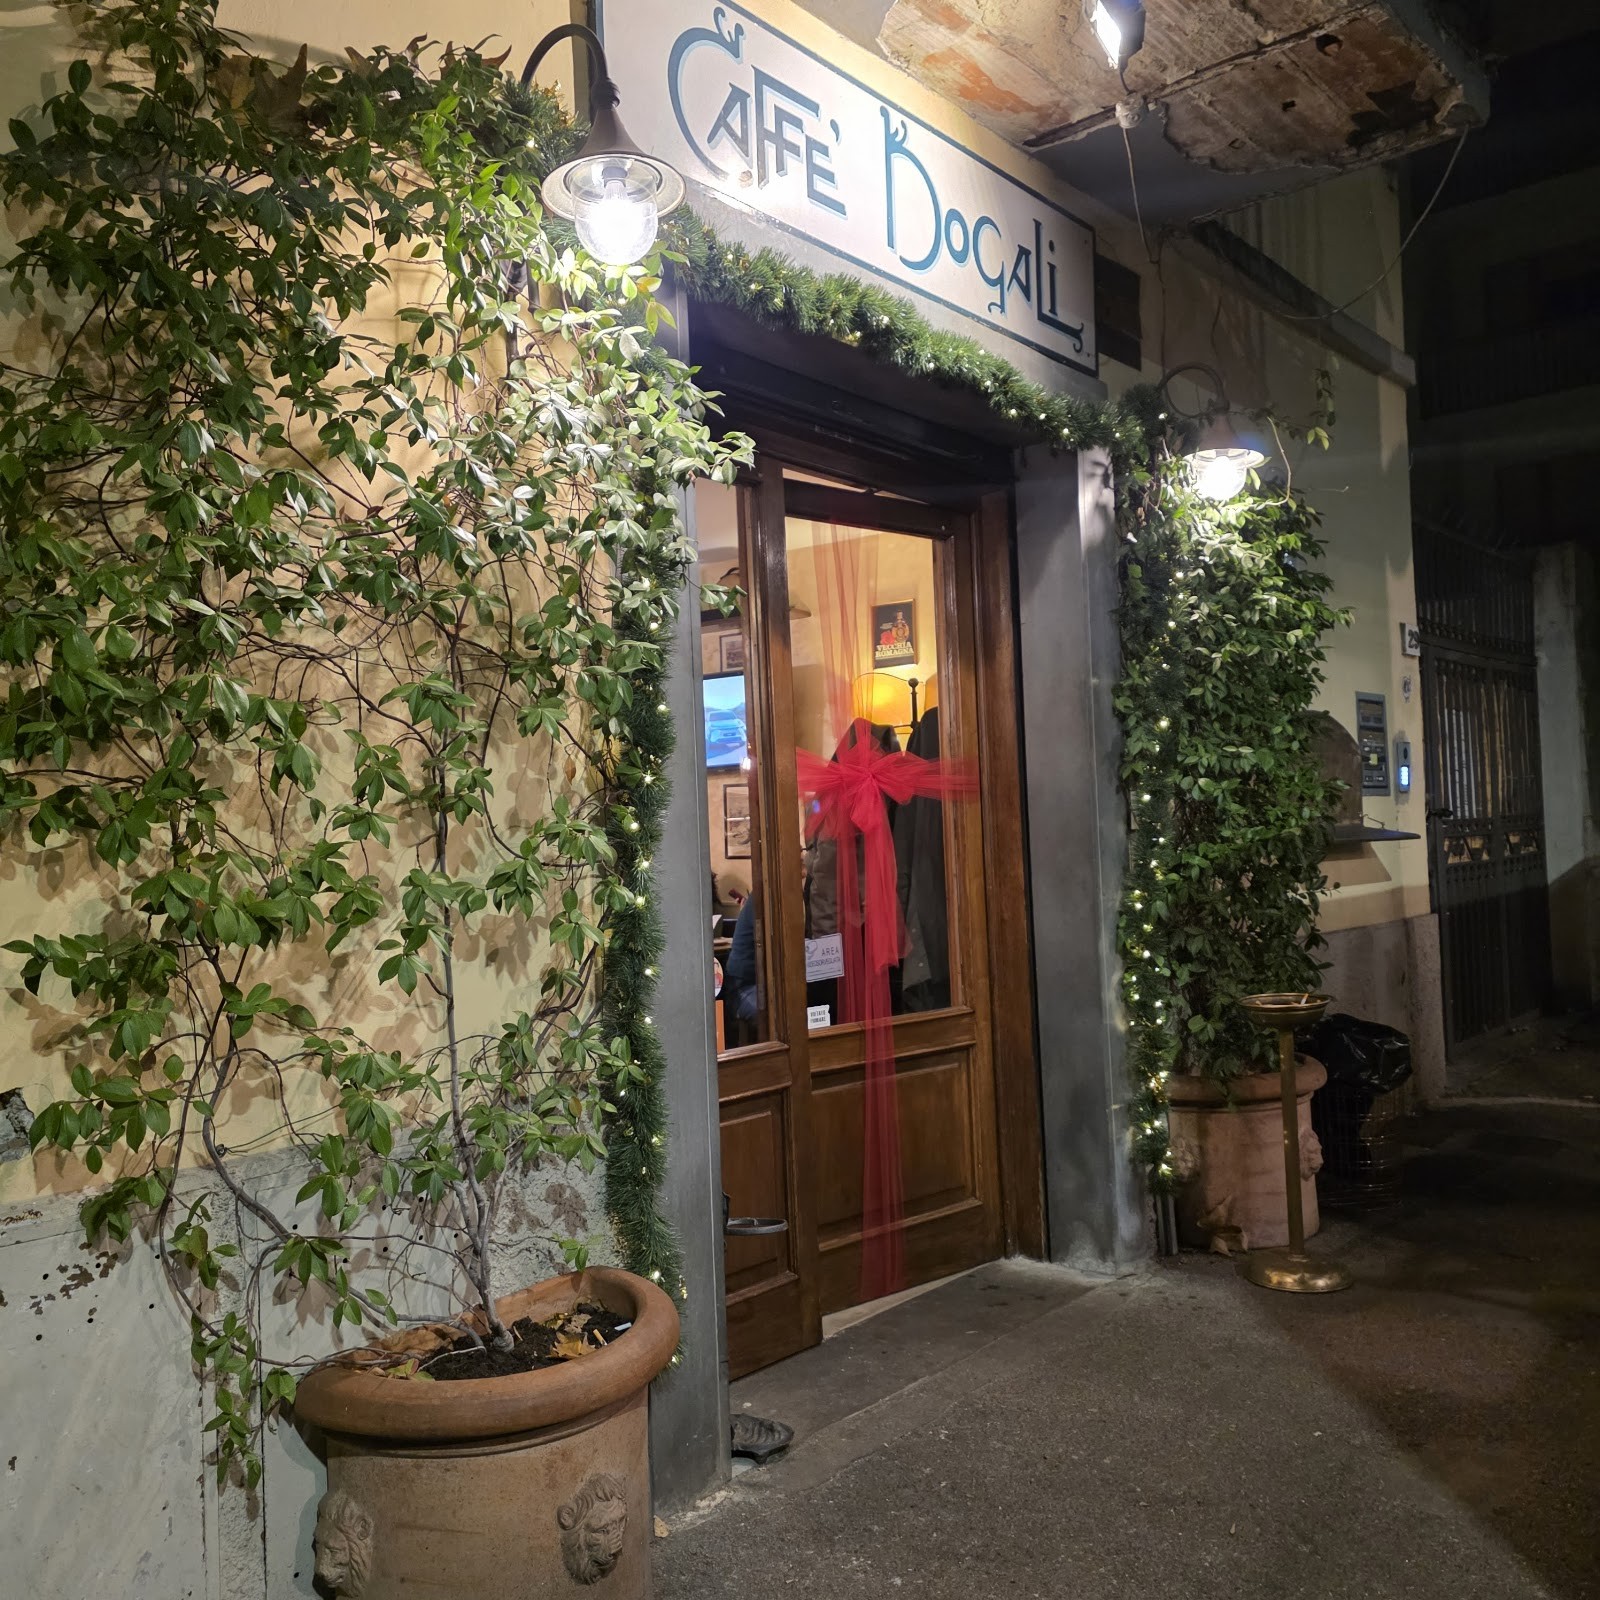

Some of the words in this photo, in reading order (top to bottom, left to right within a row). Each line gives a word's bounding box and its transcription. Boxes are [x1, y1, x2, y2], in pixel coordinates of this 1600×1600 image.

[876, 641, 913, 652] VECCHIA
[875, 647, 915, 658] ROMAGNA
[821, 946, 840, 956] AREA
